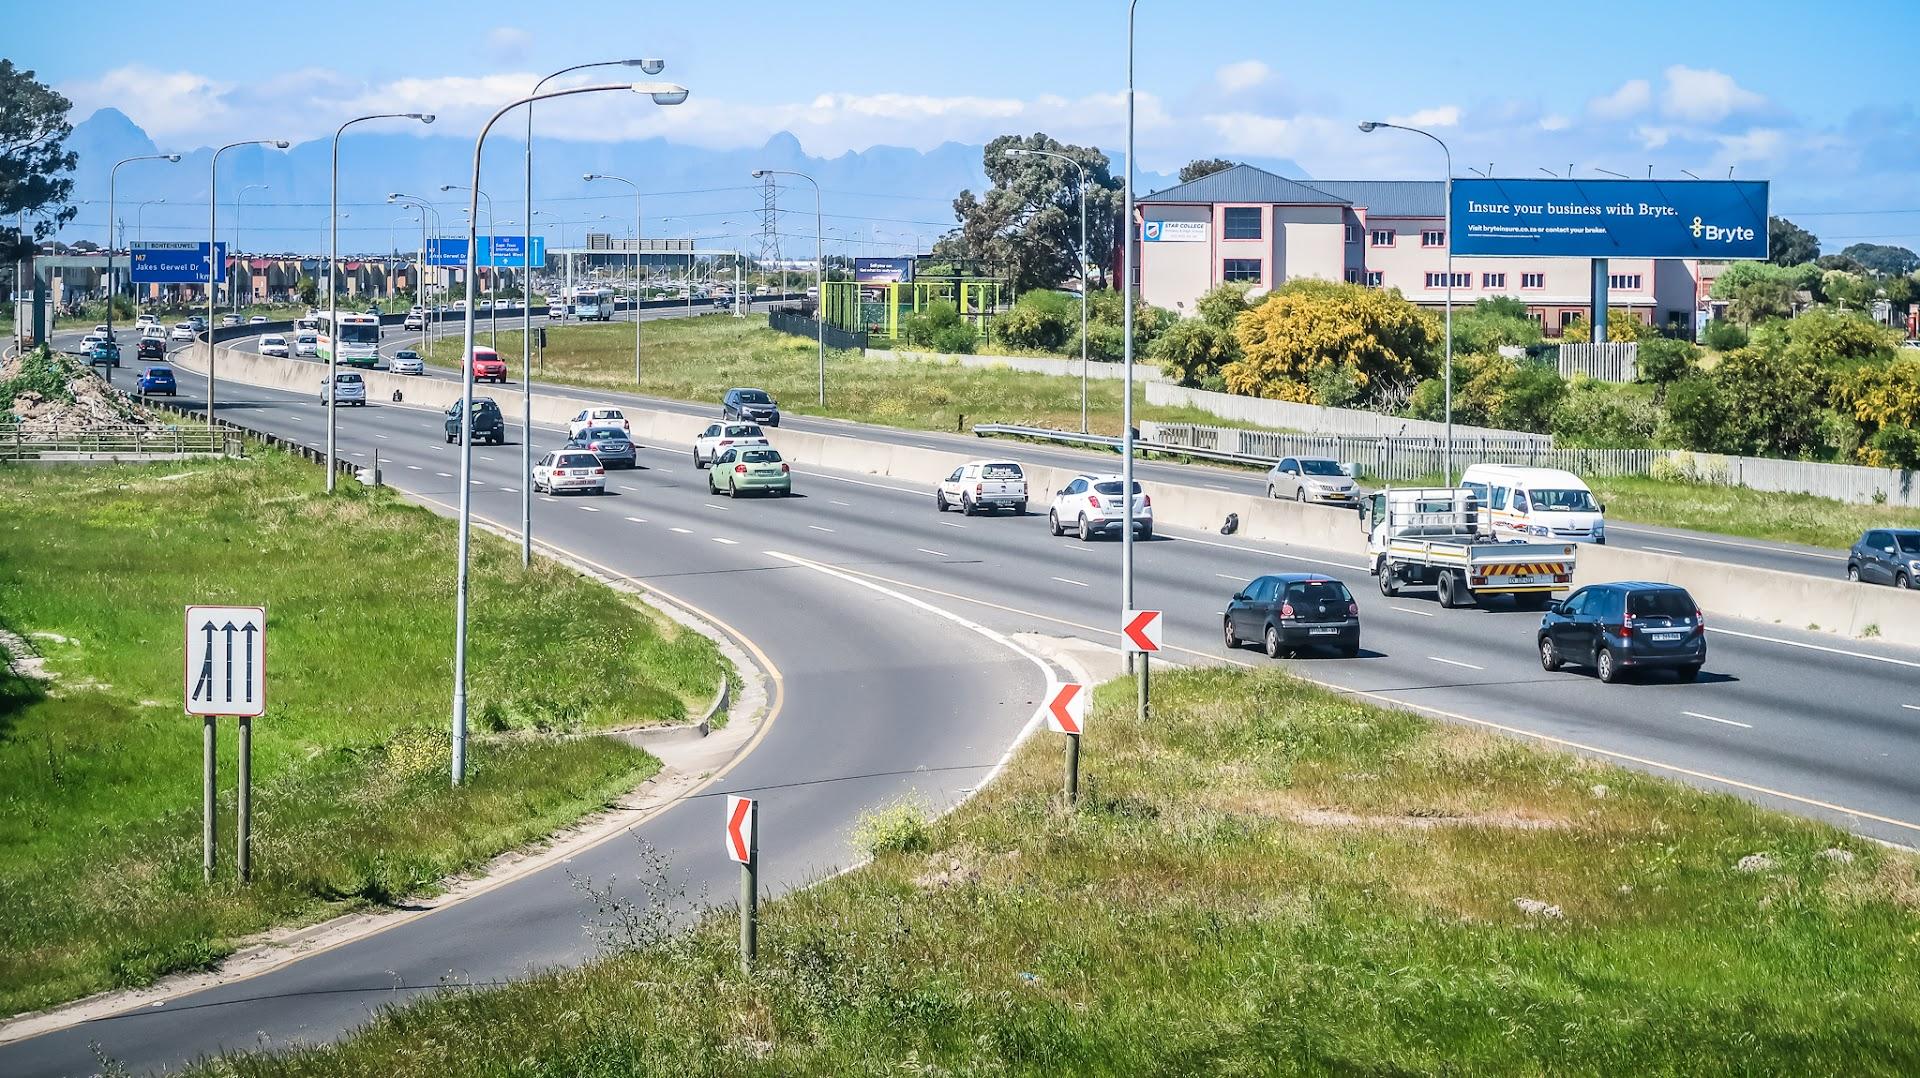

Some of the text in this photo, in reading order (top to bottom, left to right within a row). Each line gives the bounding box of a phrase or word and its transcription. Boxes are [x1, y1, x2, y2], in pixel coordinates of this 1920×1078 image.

[1468, 200, 1678, 218] Insure your business with Bryte.
[1483, 225, 1537, 233] bryteinsure.co.za
[1569, 227, 1585, 235] your
[1584, 226, 1607, 234] broker.
[1705, 225, 1755, 243] Bryte
[135, 254, 147, 262] M7
[136, 263, 200, 271] Jakes Gerwel Dr
